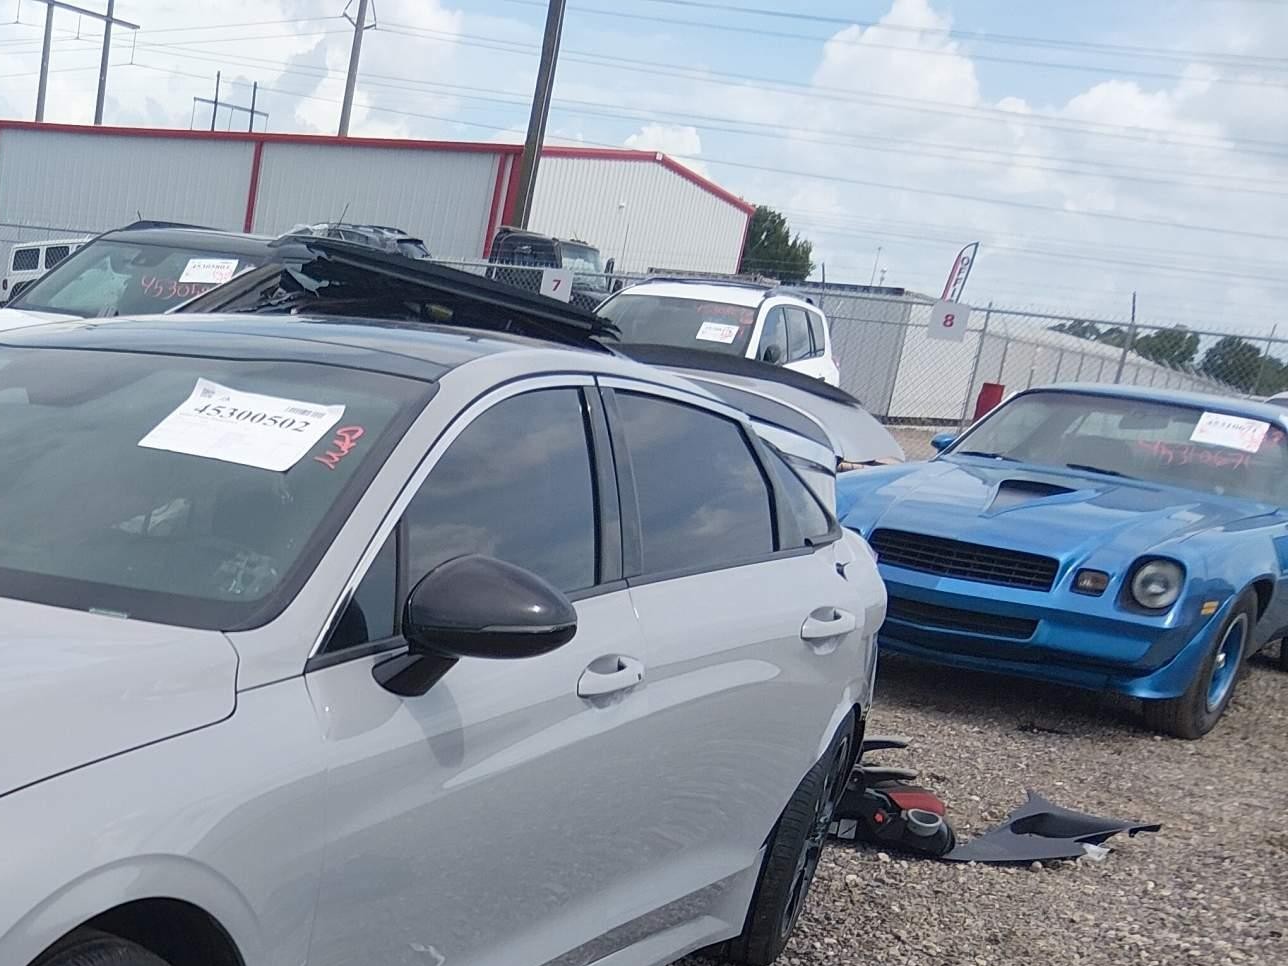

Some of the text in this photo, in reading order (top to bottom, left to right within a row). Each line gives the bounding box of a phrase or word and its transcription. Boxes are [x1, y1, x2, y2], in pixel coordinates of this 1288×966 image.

[552, 279, 561, 292] 7
[943, 314, 955, 328] 8
[194, 403, 311, 433] 45300502
